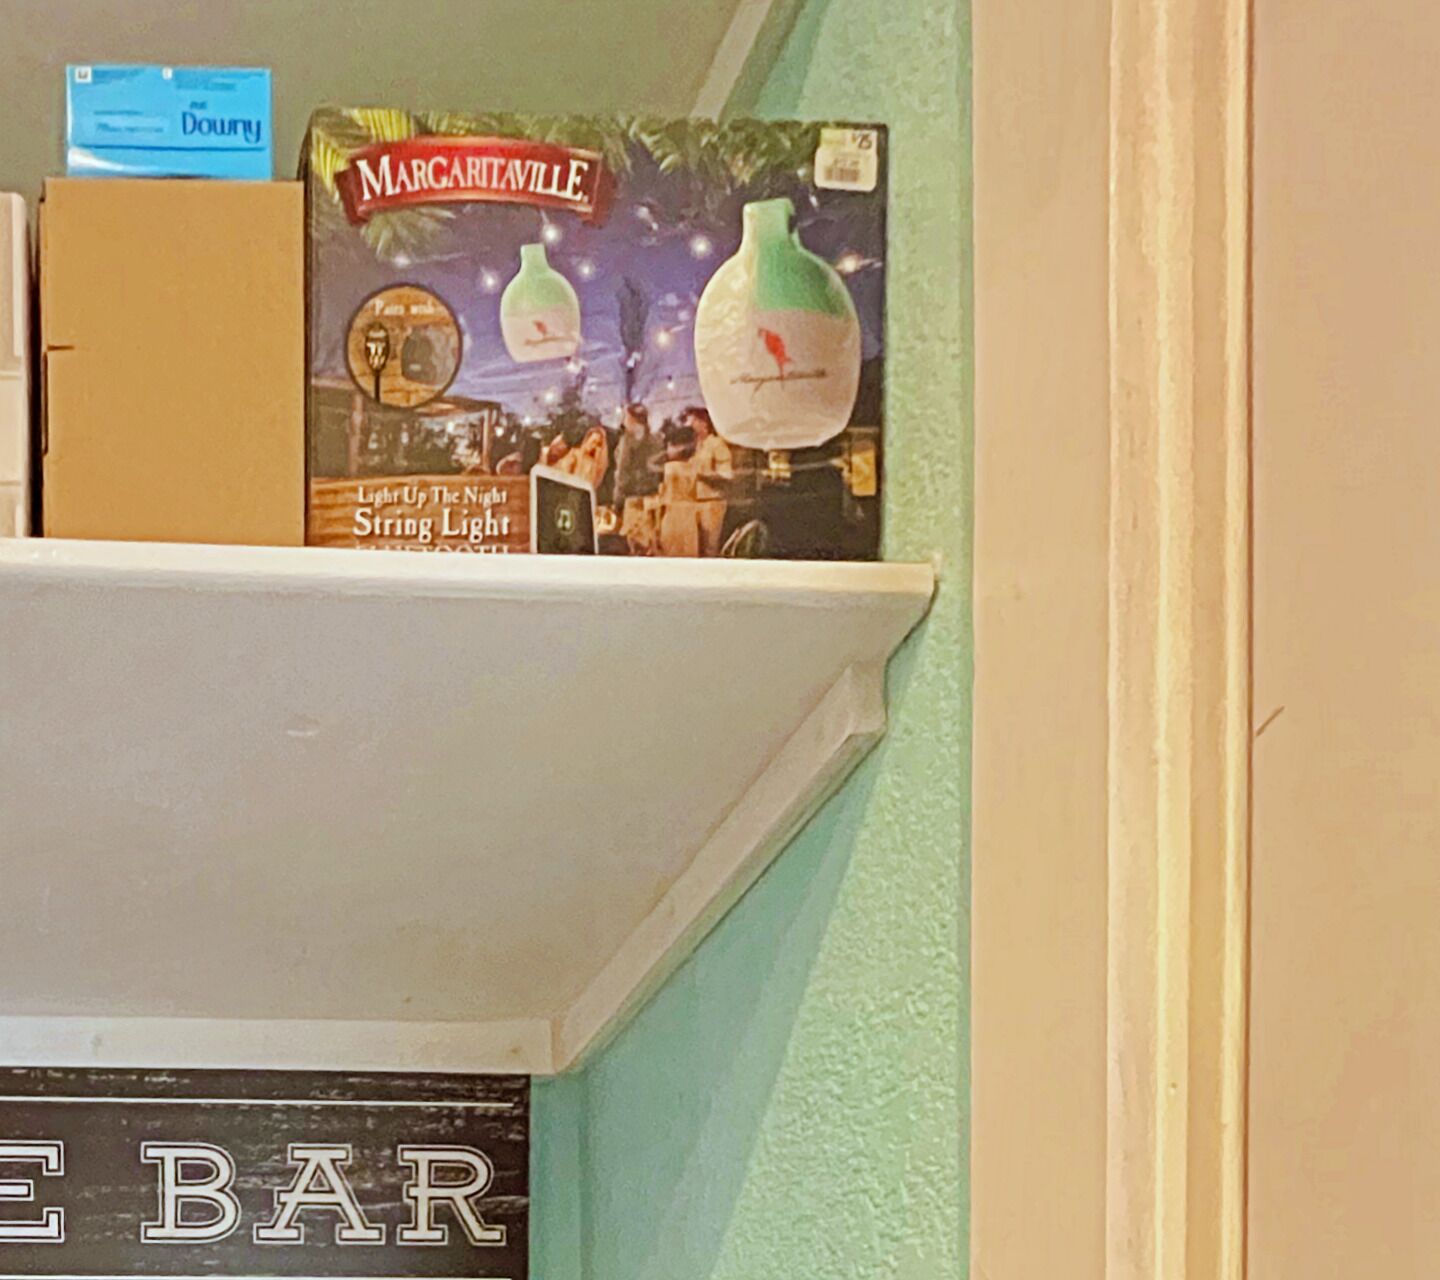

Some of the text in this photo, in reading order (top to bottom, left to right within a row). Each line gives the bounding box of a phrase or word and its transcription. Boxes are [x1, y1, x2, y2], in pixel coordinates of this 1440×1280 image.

[181, 111, 262, 144] Downy
[356, 154, 589, 202] MARGARITAVILLE
[358, 485, 507, 509] Light Up The Night
[353, 507, 510, 544] String Light
[140, 1140, 507, 1246] BAR
